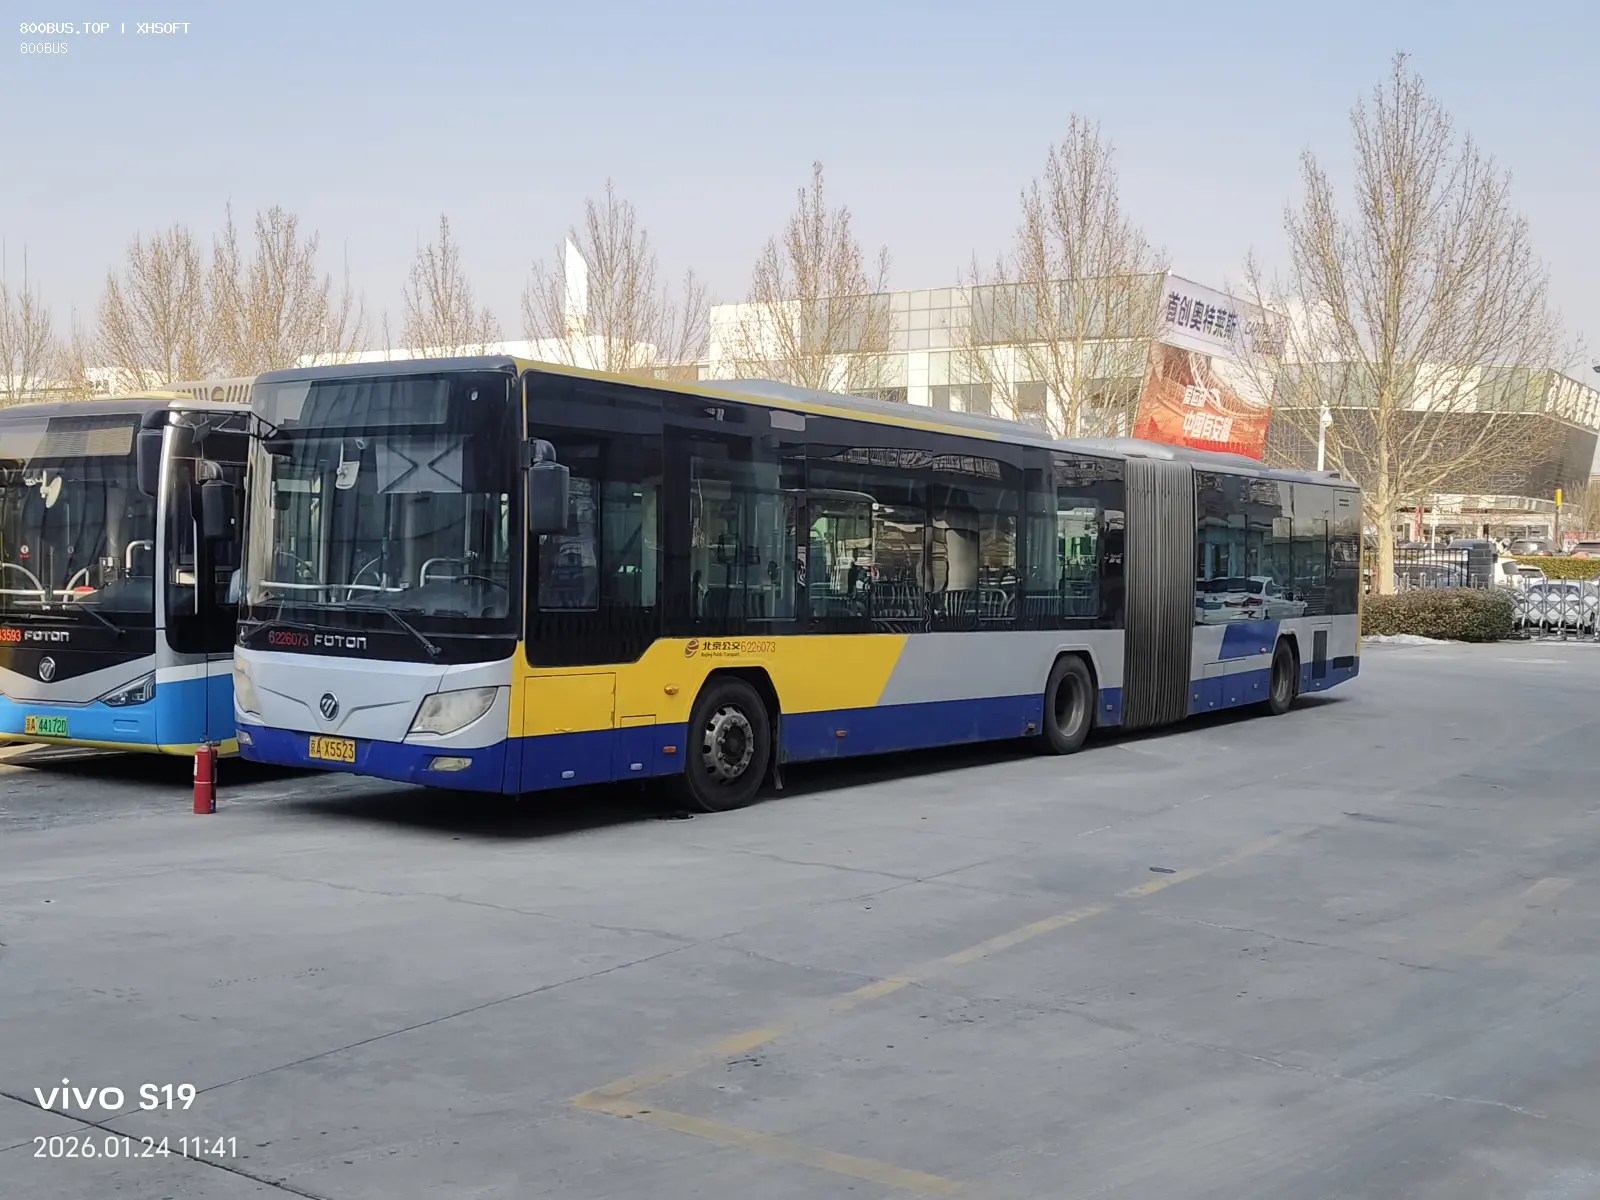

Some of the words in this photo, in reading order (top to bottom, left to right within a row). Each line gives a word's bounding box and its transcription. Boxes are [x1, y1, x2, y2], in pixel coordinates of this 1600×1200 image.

[1165, 291, 1238, 341] 首创奥特莱斯
[0, 629, 21, 642] 3593
[24, 630, 70, 642] FOTON
[268, 630, 309, 647] 6226073
[314, 634, 367, 650] FOTON
[702, 641, 740, 651] 北京公交
[740, 641, 776, 653] 6226073
